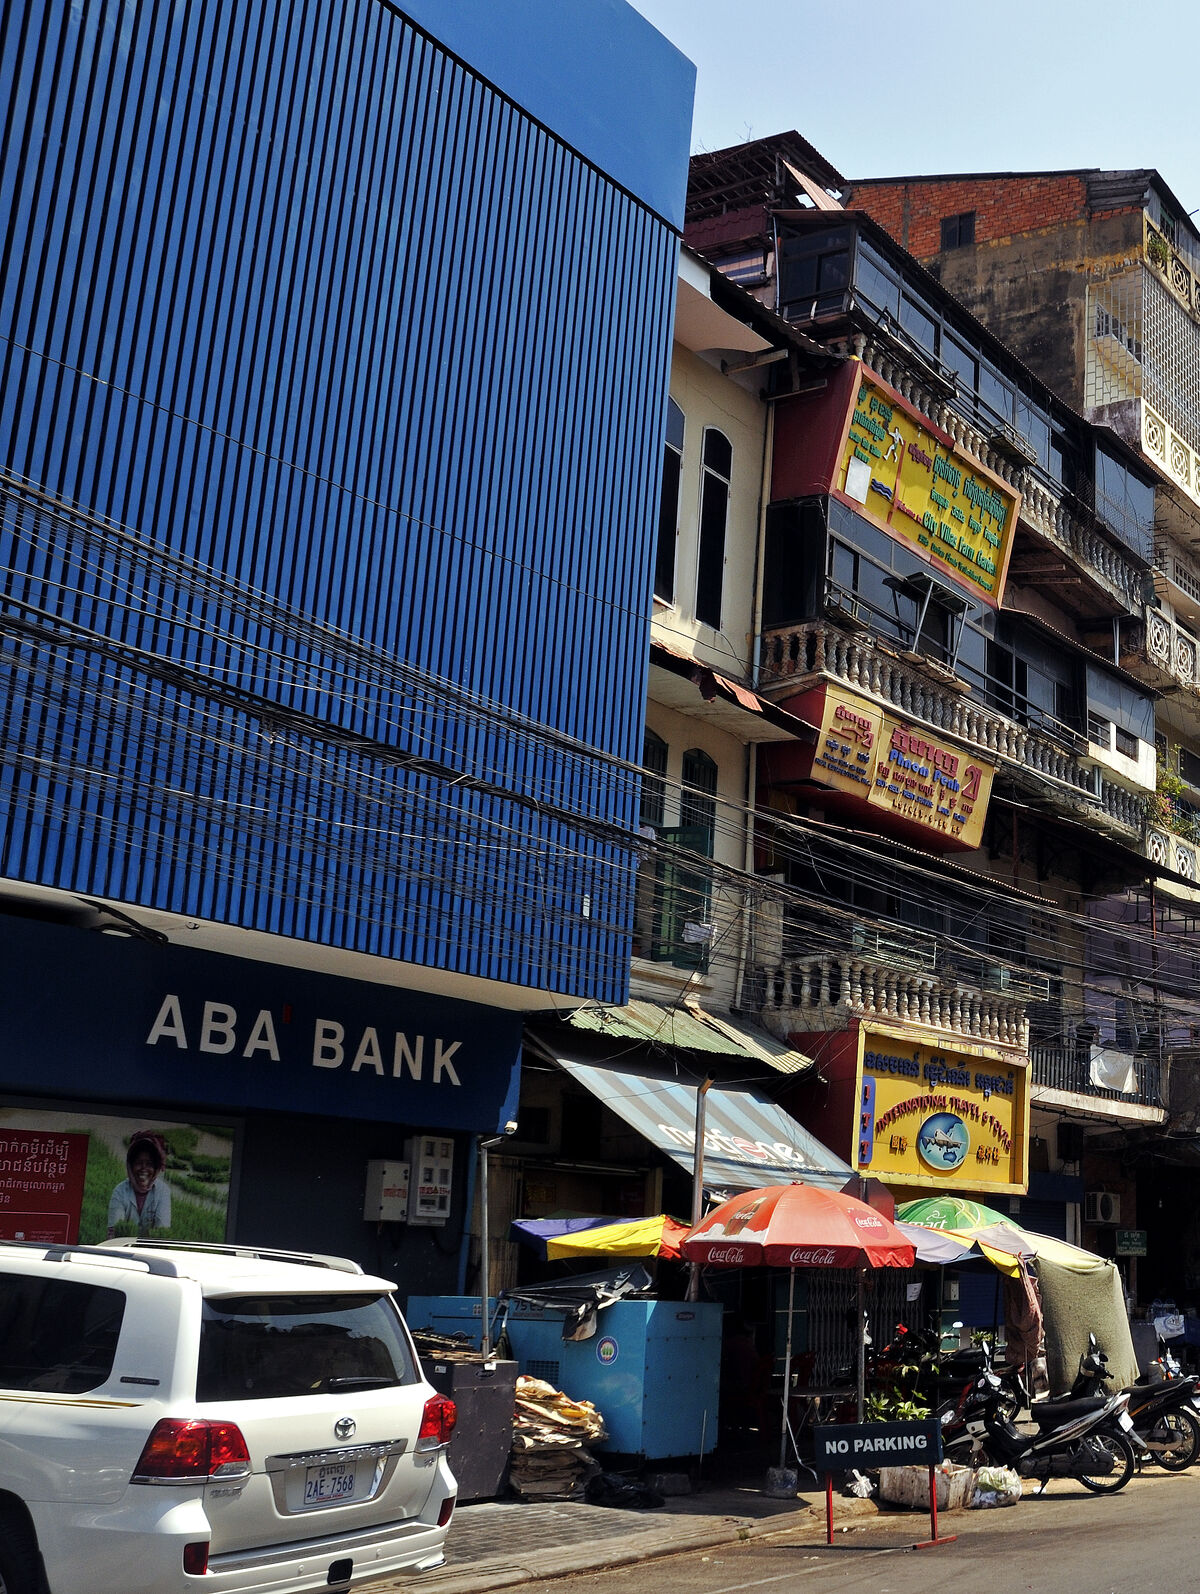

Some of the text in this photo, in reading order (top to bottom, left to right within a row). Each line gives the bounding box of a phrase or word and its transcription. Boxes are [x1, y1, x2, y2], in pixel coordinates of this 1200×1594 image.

[923, 511, 938, 537] City
[889, 749, 929, 778] Phnom
[933, 770, 960, 793] Penh
[146, 994, 463, 1086] ABA BANK
[876, 1094, 1014, 1150] INTERNATIONAL TRAVEL & TOURS
[901, 1219, 947, 1229] mart
[825, 1435, 928, 1454] NO PARKING
[306, 1475, 354, 1498] 2AE-7568
